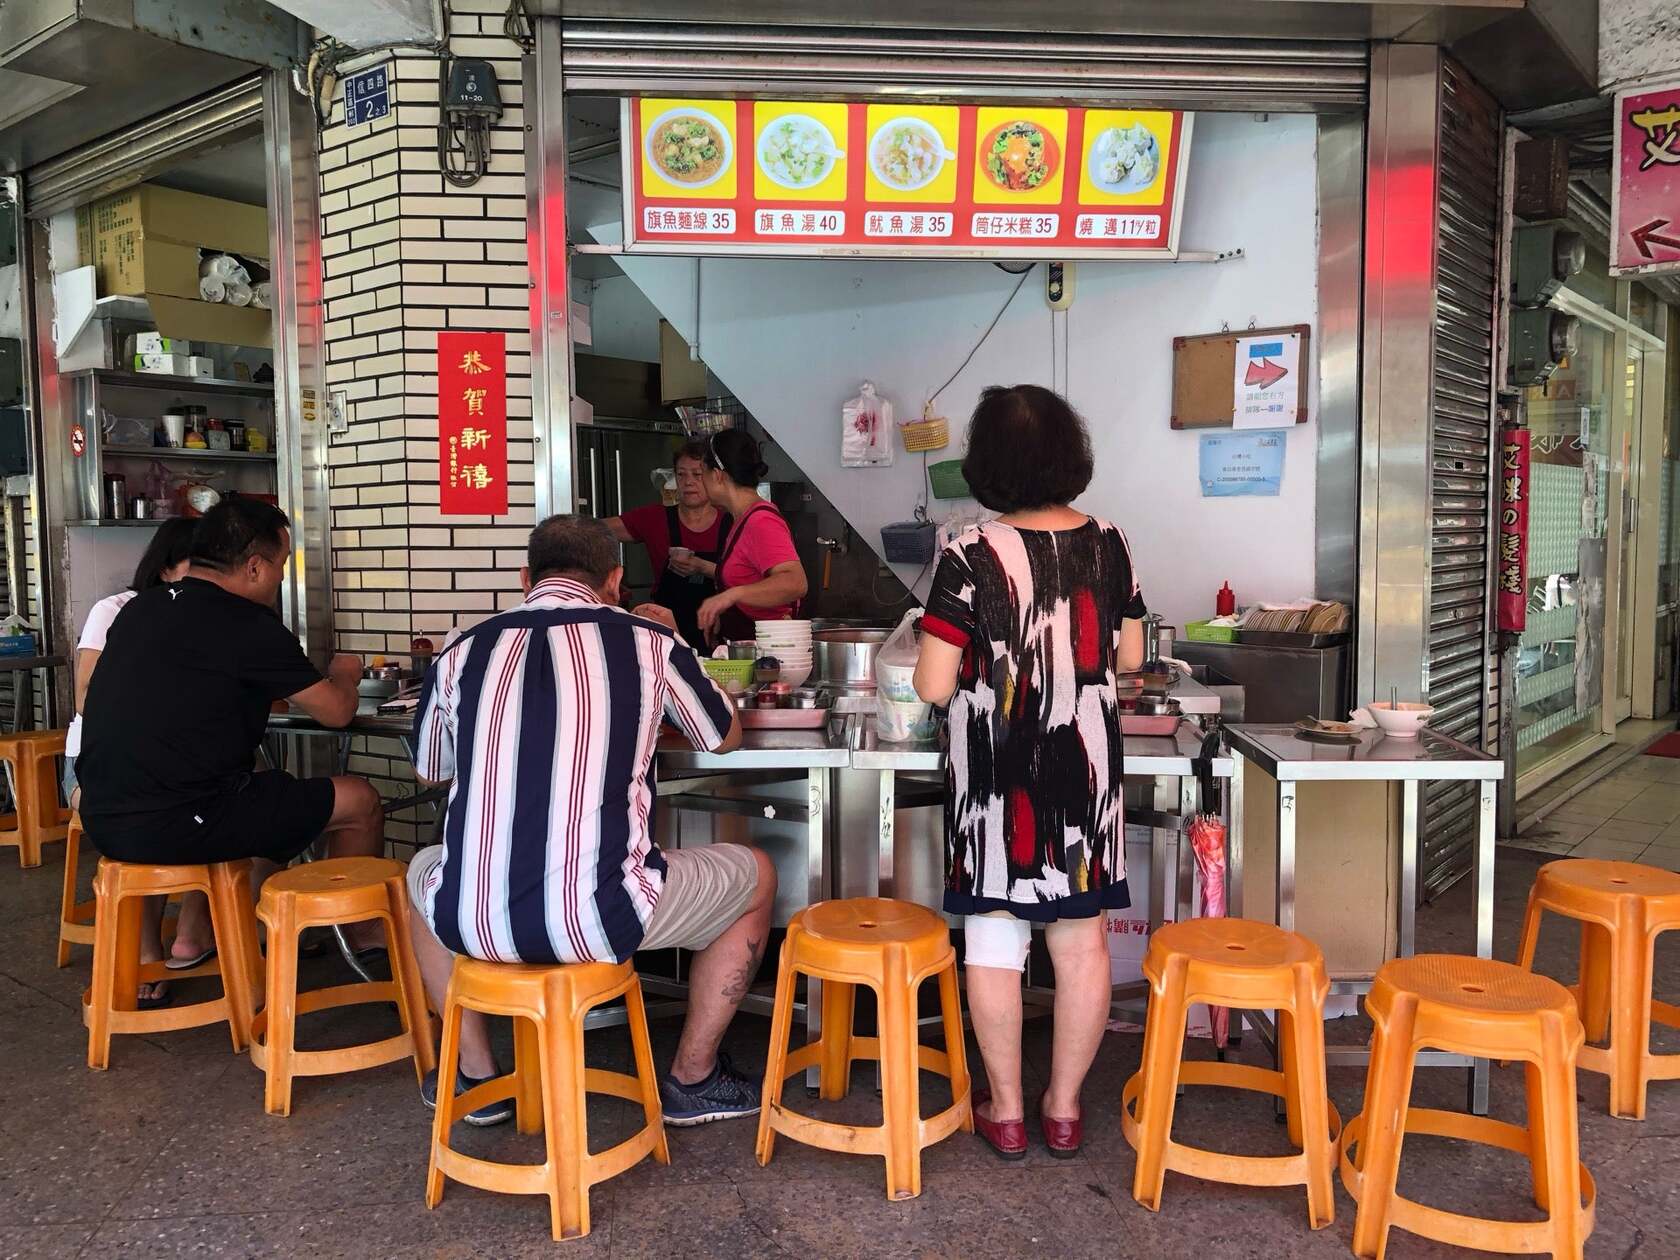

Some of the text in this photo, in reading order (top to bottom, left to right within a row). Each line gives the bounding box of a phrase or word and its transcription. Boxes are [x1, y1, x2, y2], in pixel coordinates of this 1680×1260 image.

[357, 74, 384, 94] 信四路
[647, 211, 730, 230] 旗魚麵線 35
[760, 213, 837, 232] 旗魚湯 40
[869, 215, 945, 233] 魷魚湯 35
[976, 216, 1052, 235] 筒仔米糕 35
[457, 350, 493, 489] 恭賀新禧
